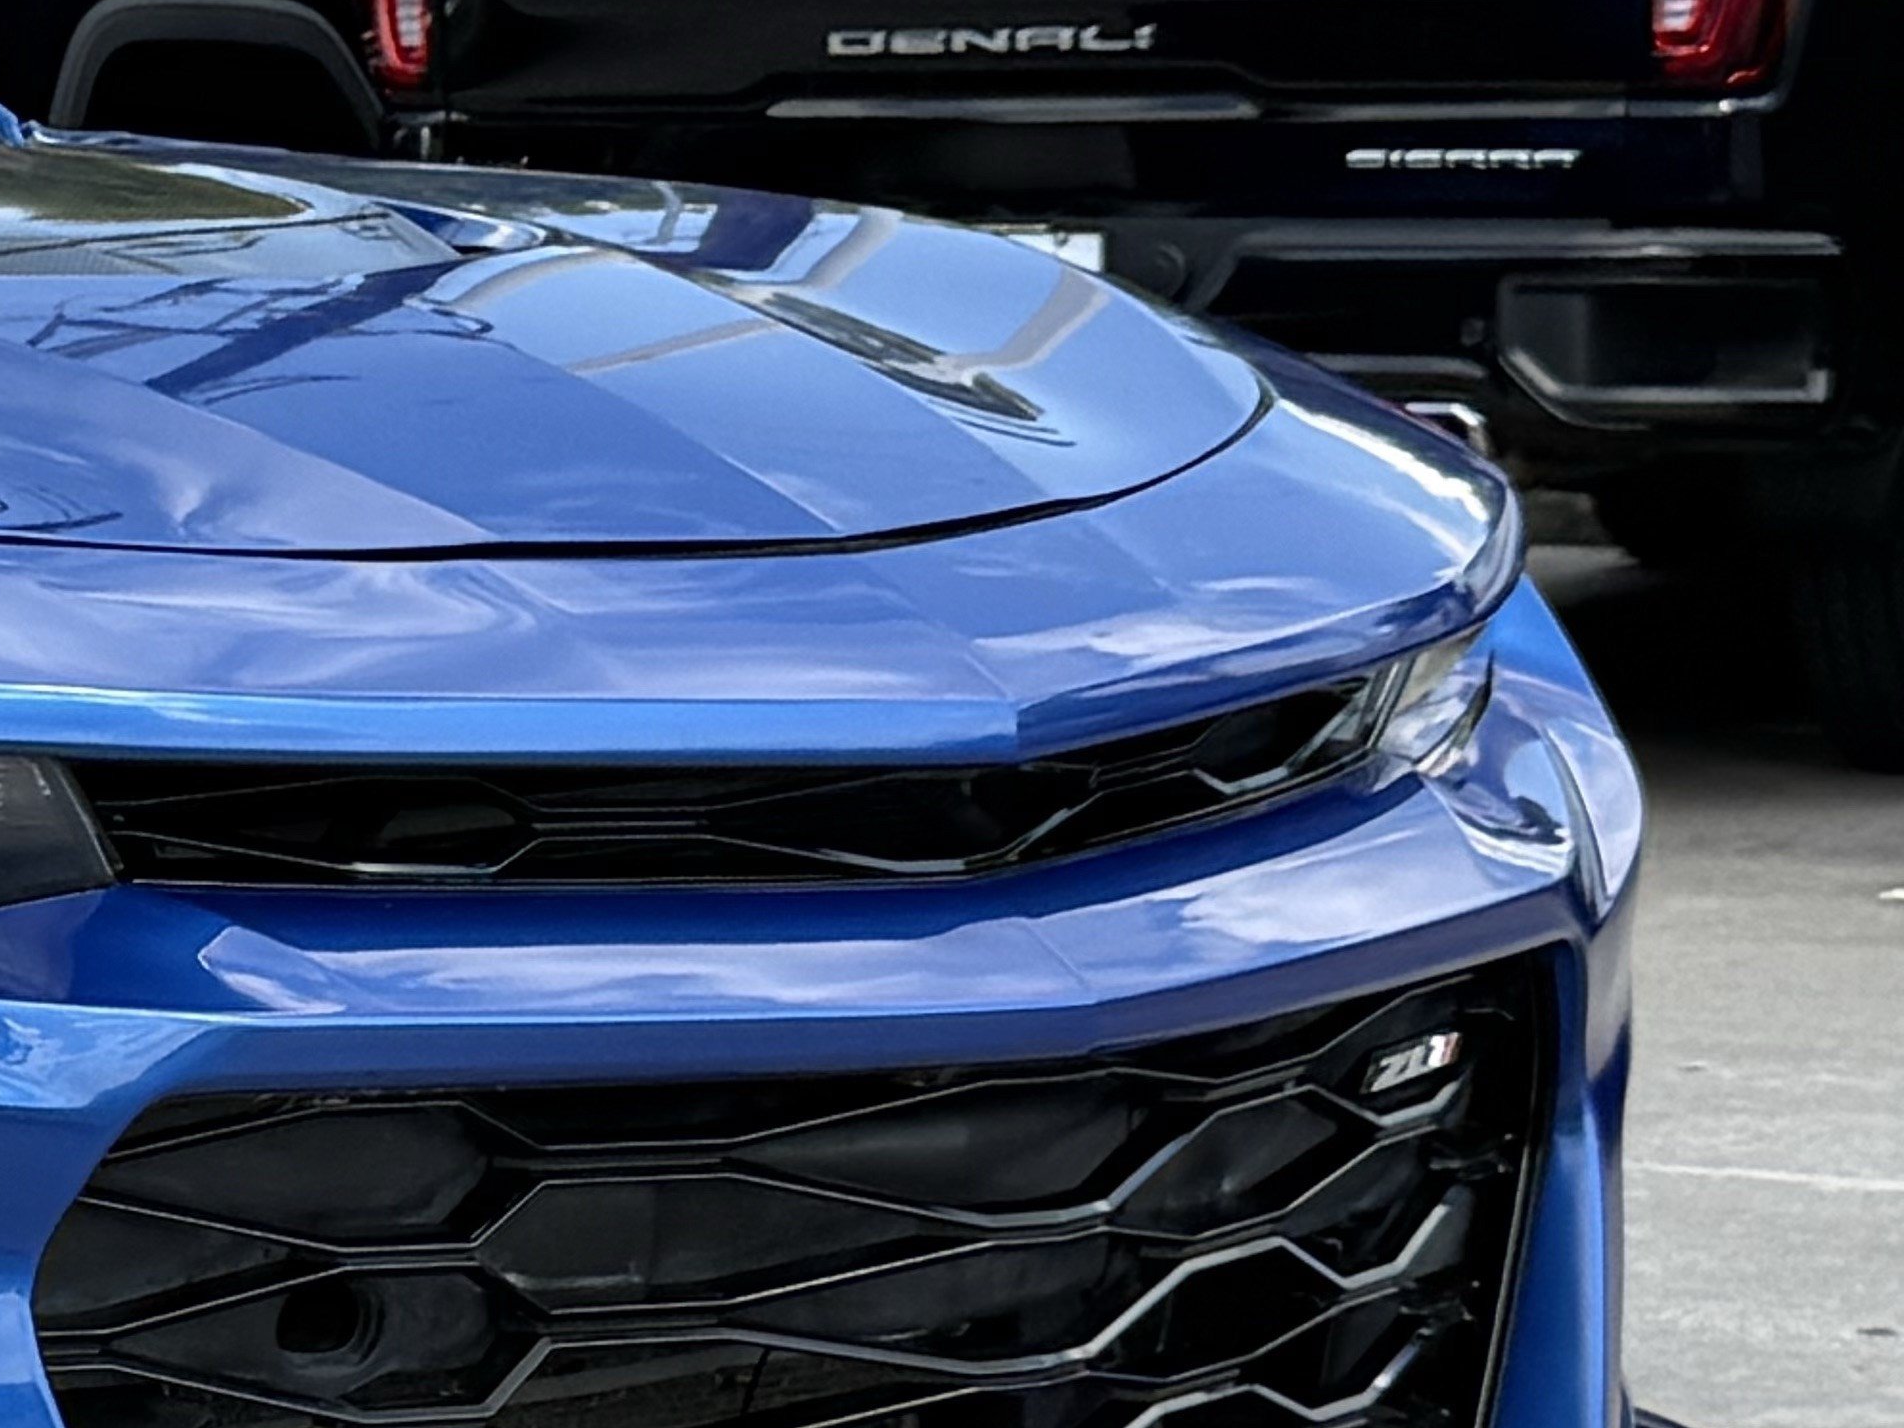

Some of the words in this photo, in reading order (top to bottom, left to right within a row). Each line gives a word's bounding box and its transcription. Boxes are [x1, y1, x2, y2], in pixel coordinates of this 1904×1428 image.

[826, 22, 1158, 56] DENALI
[1345, 148, 1582, 170] SIERRA
[1369, 1033, 1449, 1093] ZL1
